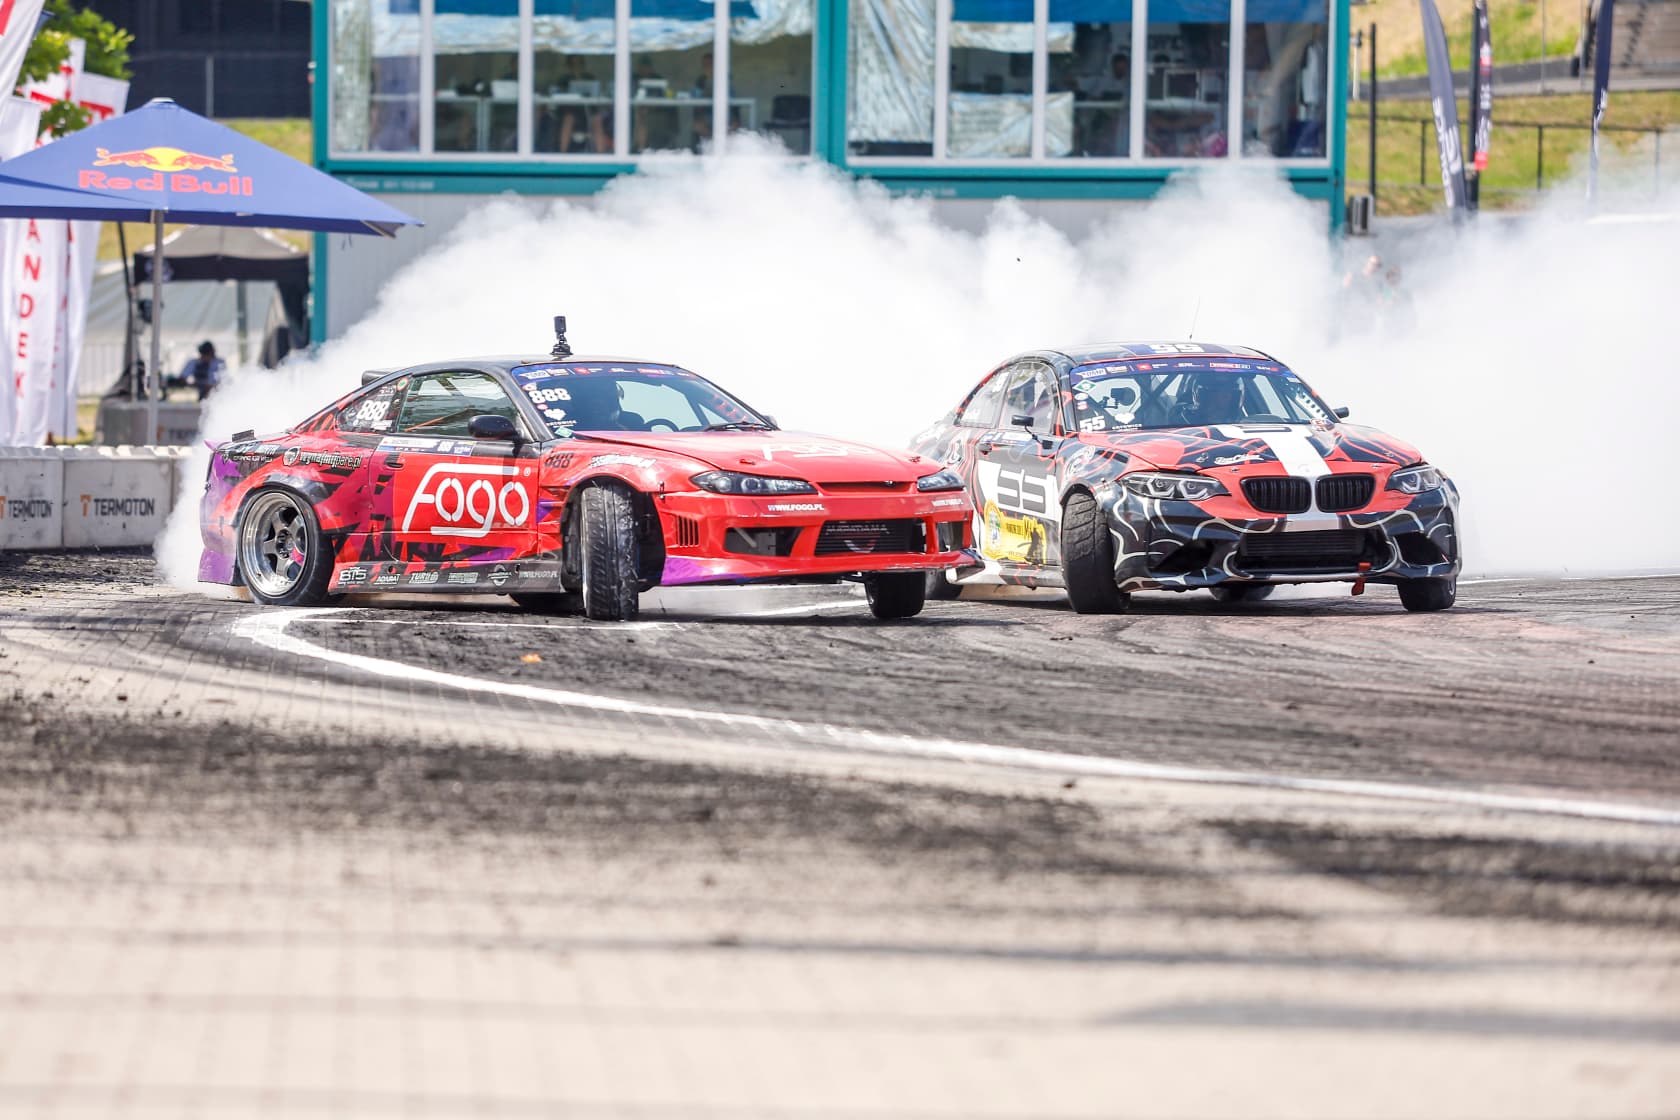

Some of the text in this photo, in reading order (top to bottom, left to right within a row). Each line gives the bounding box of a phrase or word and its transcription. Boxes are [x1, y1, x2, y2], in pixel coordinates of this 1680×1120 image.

[79, 170, 253, 196] Red Bull
[528, 388, 572, 404] 888
[356, 400, 390, 420] 888
[1080, 415, 1106, 433] 55
[8, 499, 52, 518] TERMOTON
[93, 498, 155, 517] TERMOTON
[767, 503, 825, 511] WWW.FOGO.PL
